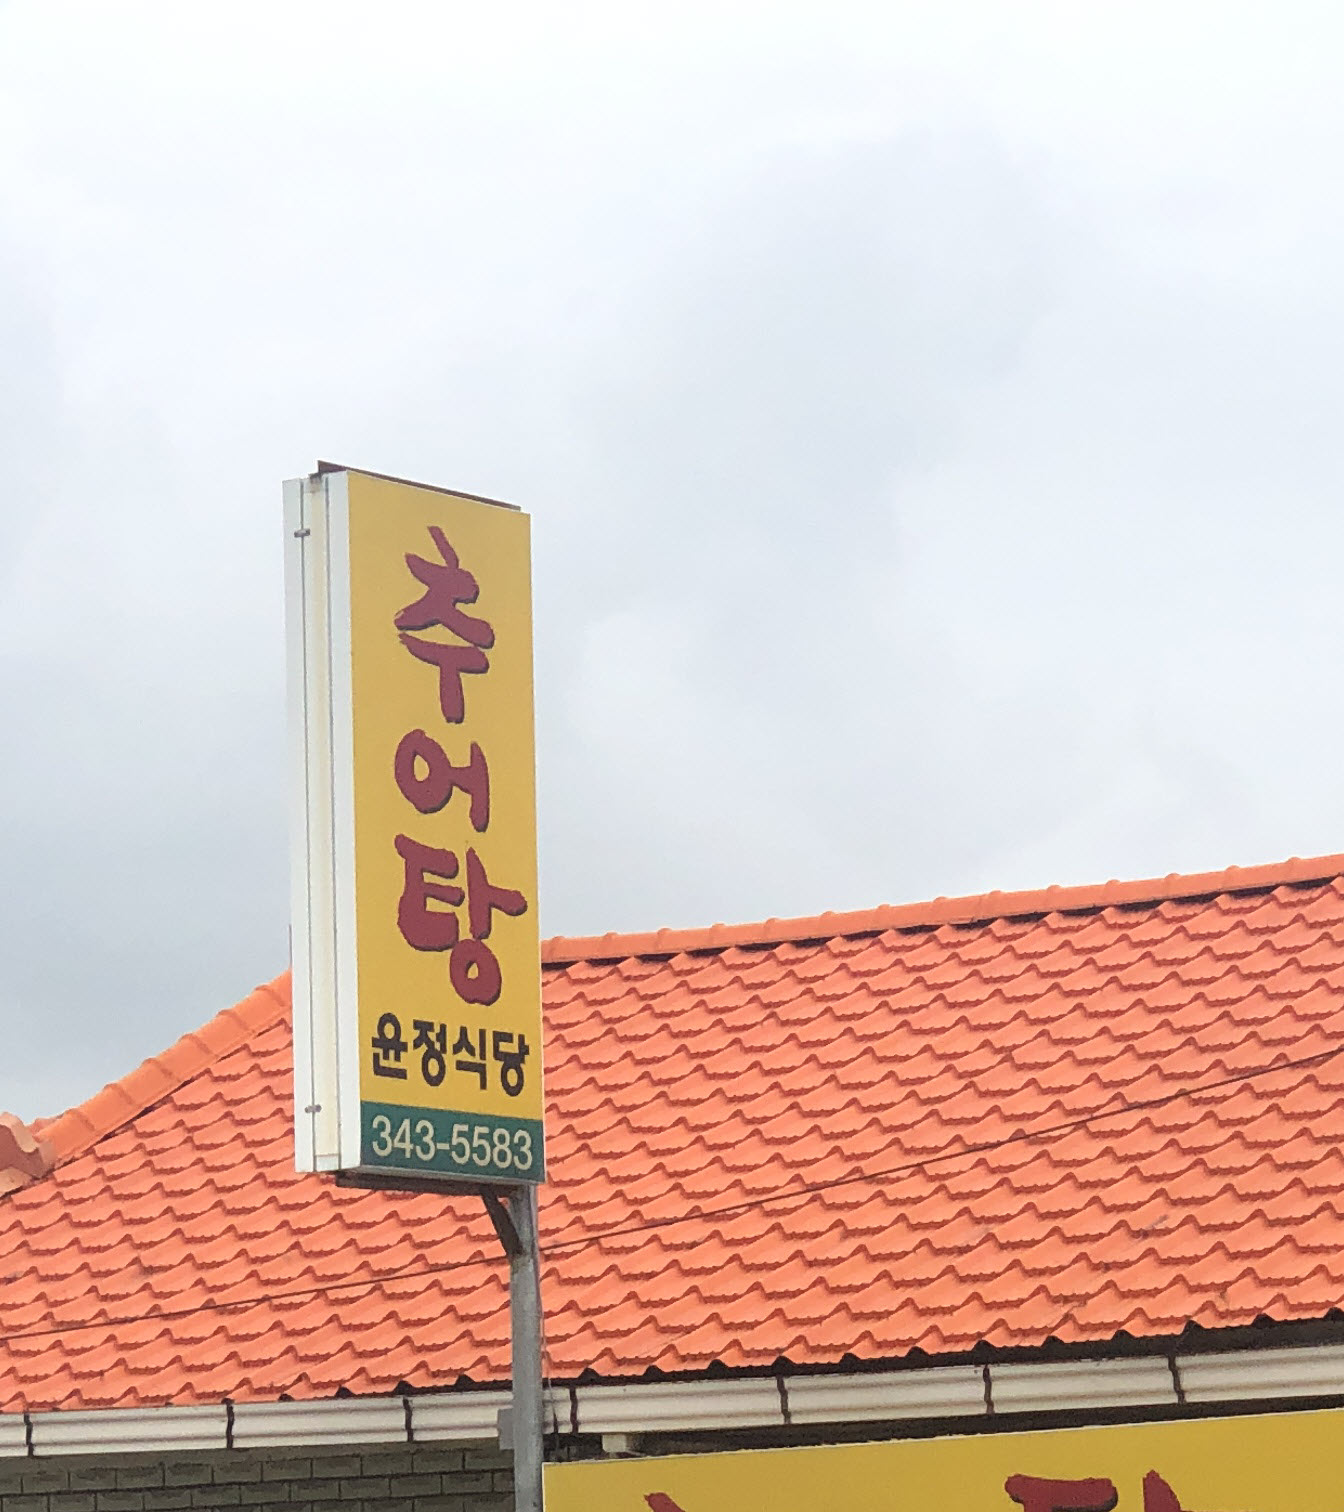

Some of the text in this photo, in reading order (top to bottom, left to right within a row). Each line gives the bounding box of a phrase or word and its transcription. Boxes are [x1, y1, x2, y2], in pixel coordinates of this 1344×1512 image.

[393, 525, 528, 1007] 추어탕
[371, 1012, 530, 1097] 윤정식당
[371, 1114, 534, 1170] 343-5583
